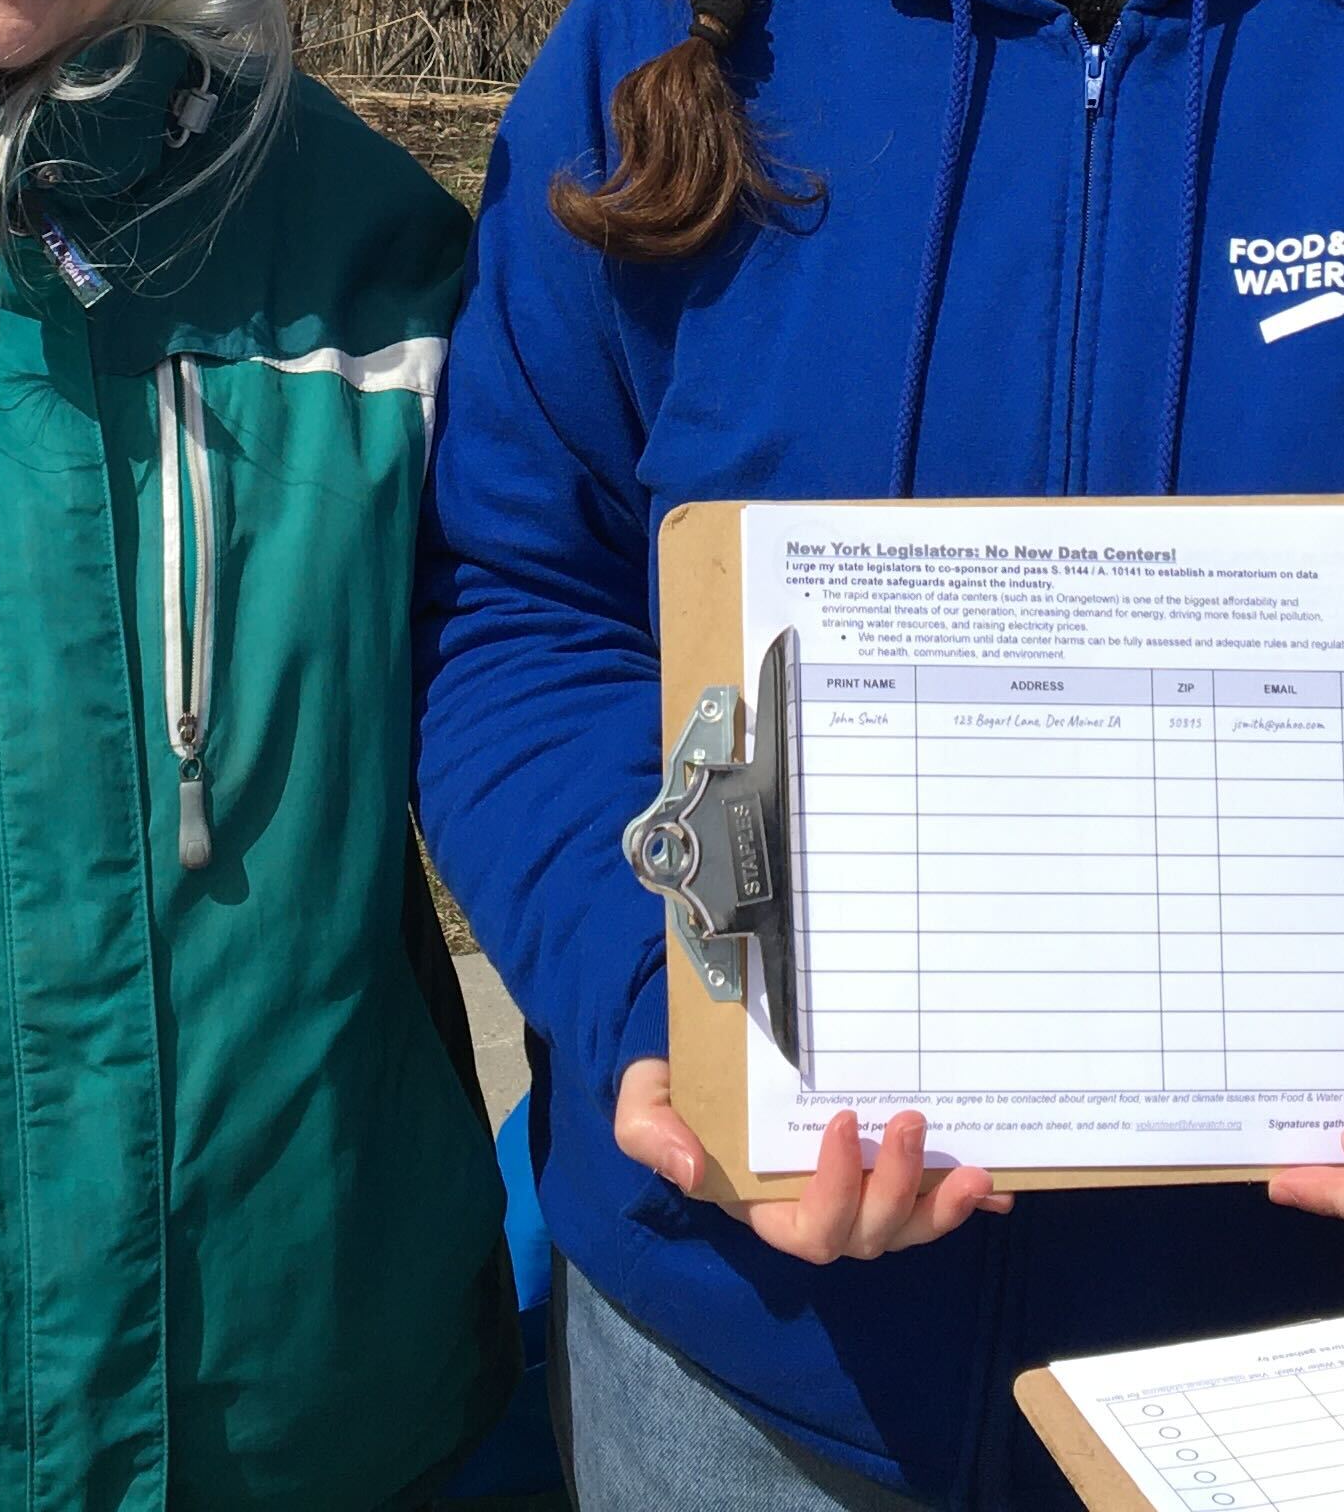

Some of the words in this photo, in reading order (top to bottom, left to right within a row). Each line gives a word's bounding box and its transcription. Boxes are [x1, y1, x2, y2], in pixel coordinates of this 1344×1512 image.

[786, 542, 826, 555] New
[830, 542, 871, 556] York
[876, 544, 979, 561] Legislators:
[984, 545, 1009, 558] No
[1014, 545, 1053, 559] New
[1057, 546, 1098, 559] Data
[1102, 547, 1176, 560] Centers!
[785, 561, 789, 570] I
[792, 563, 816, 573] urge
[818, 563, 835, 573] my
[837, 562, 864, 571] state
[866, 562, 921, 574] legislators
[924, 563, 935, 572] to
[937, 565, 998, 575] co-sponsor
[1000, 564, 1020, 573] and
[1023, 566, 1048, 576] pass
[1111, 566, 1140, 575] 10141
[1144, 566, 1155, 576] to
[1157, 567, 1205, 576] establish
[1207, 569, 1214, 577] a
[1216, 568, 1277, 578] moratorium
[1295, 569, 1318, 579] data
[785, 575, 825, 584] centers
[827, 575, 848, 585] and
[850, 576, 883, 585] create
[886, 577, 945, 588] safeguards
[947, 577, 987, 589] against
[988, 578, 1006, 587] the
[1008, 578, 1054, 590] industry.
[821, 589, 841, 598] The
[843, 589, 869, 601] rapid
[871, 590, 922, 602] expansion
[924, 591, 935, 600] of
[936, 591, 959, 600] data
[960, 592, 998, 601] centers
[1000, 592, 1028, 604] (such
[1030, 594, 1042, 602] as
[1044, 593, 1054, 602] in
[1055, 593, 1119, 605] Orangetown)
[1121, 594, 1130, 603] is
[1132, 596, 1151, 604] one
[1153, 594, 1164, 604] of
[1165, 595, 1181, 604] the
[1183, 595, 1220, 607] biggest
[1222, 596, 1277, 608] affordability
[1280, 597, 1299, 606] and
[821, 604, 891, 613] environmental
[894, 604, 928, 614] threats
[930, 605, 941, 614] of
[942, 607, 959, 615] our
[1020, 607, 1070, 618] increasing
[1072, 607, 1112, 617] demand
[1114, 608, 1128, 617] for
[1168, 609, 1201, 621] driving
[1204, 611, 1229, 619] more
[1231, 610, 1257, 619] fossil
[1259, 610, 1277, 620] fuel
[821, 618, 864, 629] straining
[866, 618, 894, 628] water
[950, 619, 970, 629] and
[972, 620, 1005, 632] raising
[1007, 621, 1054, 632] electricity
[857, 632, 874, 641] We
[877, 632, 902, 642] need
[905, 634, 912, 642] a
[914, 633, 970, 642] moratorium
[972, 634, 993, 643] until
[996, 634, 1018, 643] data
[1020, 634, 1052, 644] center
[1054, 635, 1085, 644] harms
[1087, 637, 1105, 645] can
[1107, 636, 1121, 645] be
[1122, 636, 1143, 648] fully
[1145, 636, 1192, 646] assessed
[1194, 637, 1213, 646] and
[1215, 638, 1261, 649] adequate
[1263, 638, 1287, 648] rules
[1290, 639, 1309, 648] and
[858, 648, 875, 656] our
[981, 648, 1000, 657] and
[826, 678, 860, 689] PRINT
[863, 678, 896, 689] NAME
[1010, 680, 1065, 691] ADDRESS
[1177, 682, 1194, 693] ZIP
[1263, 683, 1297, 695] EMAIL
[828, 711, 854, 727] John
[858, 711, 889, 725] Smith
[953, 714, 973, 726] 123
[1045, 713, 1066, 728] Des
[1067, 714, 1105, 728] Moines
[1107, 714, 1122, 728] IA
